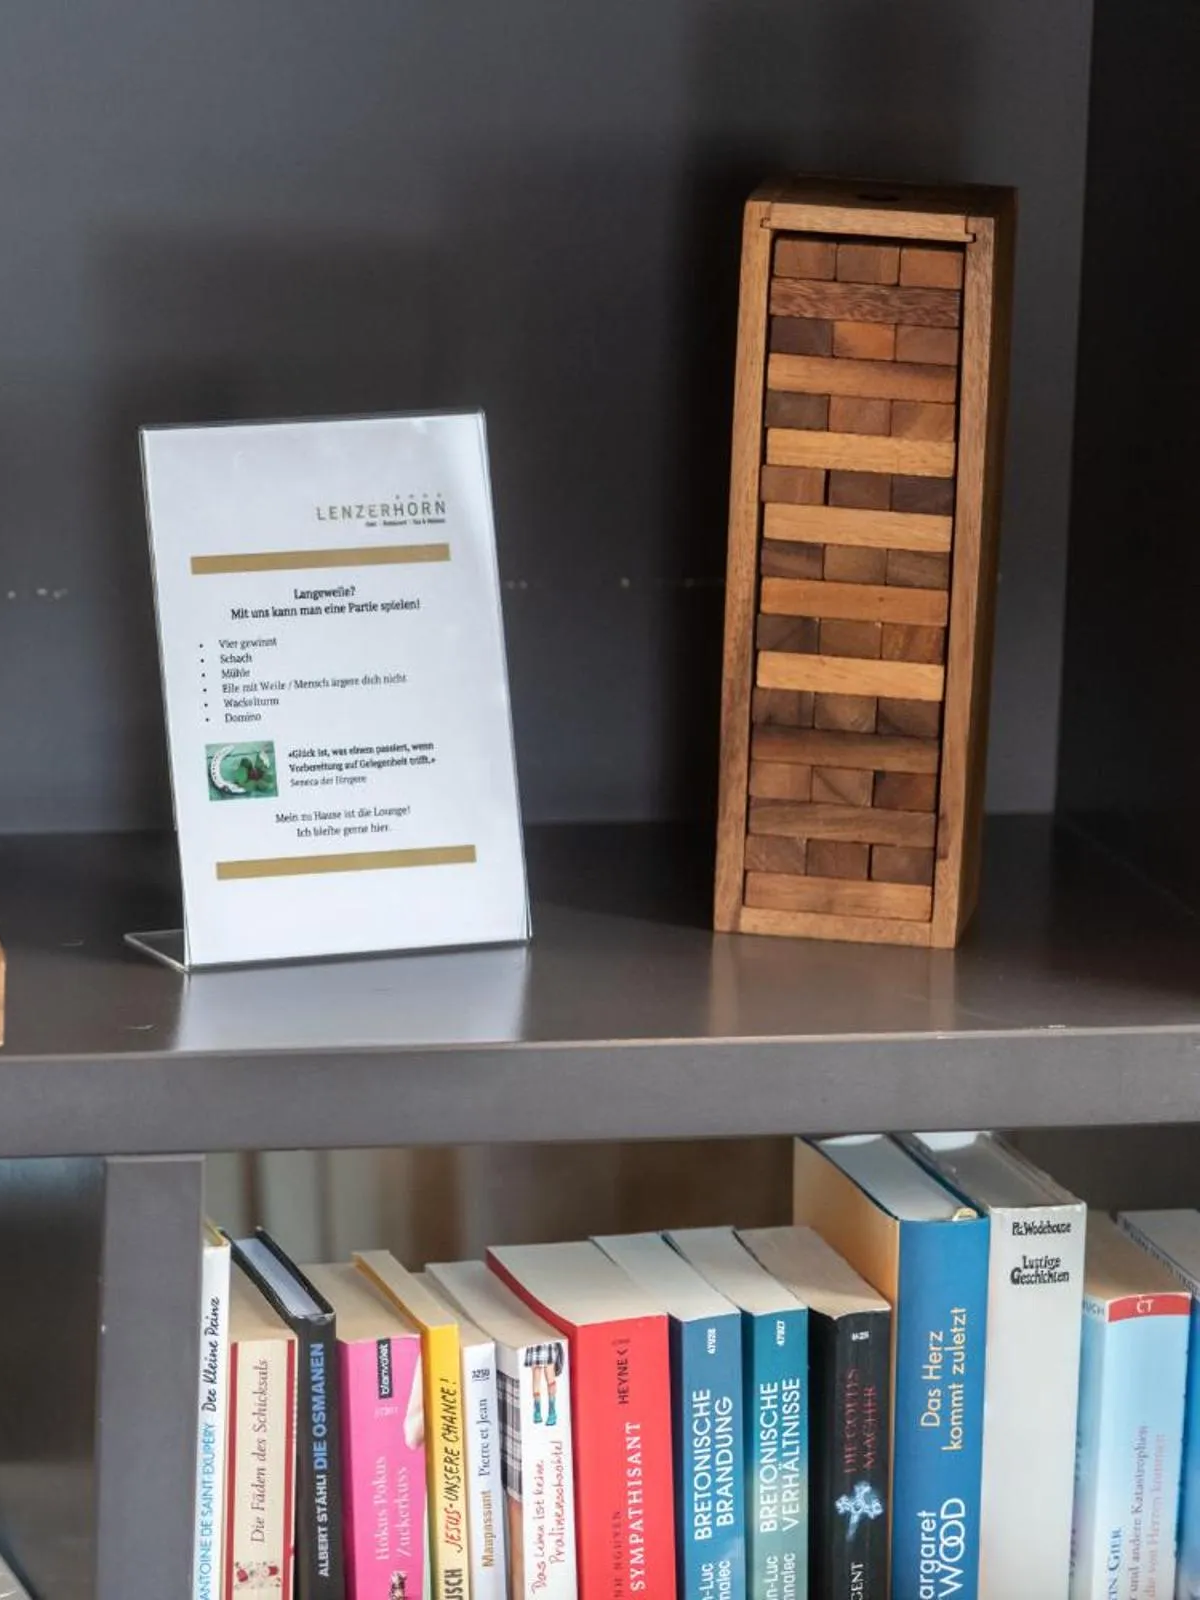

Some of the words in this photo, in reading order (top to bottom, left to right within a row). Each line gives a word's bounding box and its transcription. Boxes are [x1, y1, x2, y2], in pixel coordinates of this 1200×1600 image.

[316, 500, 446, 521] LENZERHORN
[231, 608, 249, 620] Mit
[251, 609, 270, 619] uns
[272, 606, 297, 618] kann
[300, 606, 322, 616] man
[325, 604, 346, 614] eine
[348, 602, 378, 613] Partie
[381, 599, 420, 614] spielen!
[293, 586, 356, 601] Langeweile?
[219, 639, 238, 649] Vier
[240, 637, 277, 650] gewinnt
[220, 652, 253, 664] Schach
[221, 668, 250, 679] Mühle
[243, 682, 258, 692] mit
[260, 680, 285, 691] Weile
[294, 678, 329, 689] Mensch
[361, 674, 382, 685] dich
[383, 672, 407, 684] nicht
[224, 711, 261, 723] Domino
[289, 761, 343, 773] Vorbereitung
[345, 760, 358, 770] auf
[359, 757, 407, 770] Gelegenheit
[332, 748, 348, 756] was
[349, 745, 375, 755] einem
[411, 742, 435, 751] wenn
[290, 777, 319, 788] Seneca
[275, 813, 299, 824] Mein
[300, 813, 313, 822] zu
[314, 811, 342, 821] Hause
[344, 809, 356, 818] ist
[358, 807, 372, 817] die
[374, 805, 411, 818] Lounge!
[297, 827, 311, 838] Ich
[313, 825, 341, 836] bleibe
[343, 825, 369, 837] gerne
[1010, 1267, 1070, 1286] Geschichten
[1022, 1255, 1061, 1271] Lustige
[203, 1296, 220, 1336] Prinz
[921, 1330, 944, 1380] Herz
[943, 1307, 967, 1375] zuletzt
[200, 1341, 218, 1385] Kleine
[251, 1359, 269, 1433] Schicksals
[309, 1342, 327, 1437] OSMANEN
[616, 1357, 630, 1405] HEYNE
[200, 1389, 218, 1412] Der
[475, 1398, 492, 1426] Jean
[920, 1387, 942, 1428] Das
[942, 1382, 965, 1451] kommt
[251, 1438, 267, 1461] des
[477, 1428, 490, 1440] et
[312, 1440, 328, 1470] DIE
[476, 1442, 491, 1477] Pierre
[693, 1388, 714, 1541] BRETONISCHE
[714, 1396, 735, 1527] BRANDUNG
[759, 1381, 779, 1533] BRETONISCHE
[779, 1377, 801, 1531] VERHÄLTNISSE
[1131, 1426, 1149, 1515] Katastrophen
[250, 1467, 267, 1511] Fäden
[371, 1456, 389, 1505] Pokus
[531, 1499, 545, 1520] ist
[625, 1420, 646, 1592] SYMPATHISANT
[200, 1520, 213, 1536] DE
[250, 1517, 266, 1543] Die
[374, 1510, 391, 1560] Hokus
[479, 1490, 496, 1567] Maupassant
[1129, 1518, 1142, 1563] andere
[316, 1527, 330, 1577] ALBERT
[916, 1510, 941, 1600] argaret
[198, 1540, 213, 1600] ANTOINE
[529, 1560, 548, 1594] Das
[764, 1555, 780, 1600] n-Luc
[1128, 1567, 1140, 1592] und
